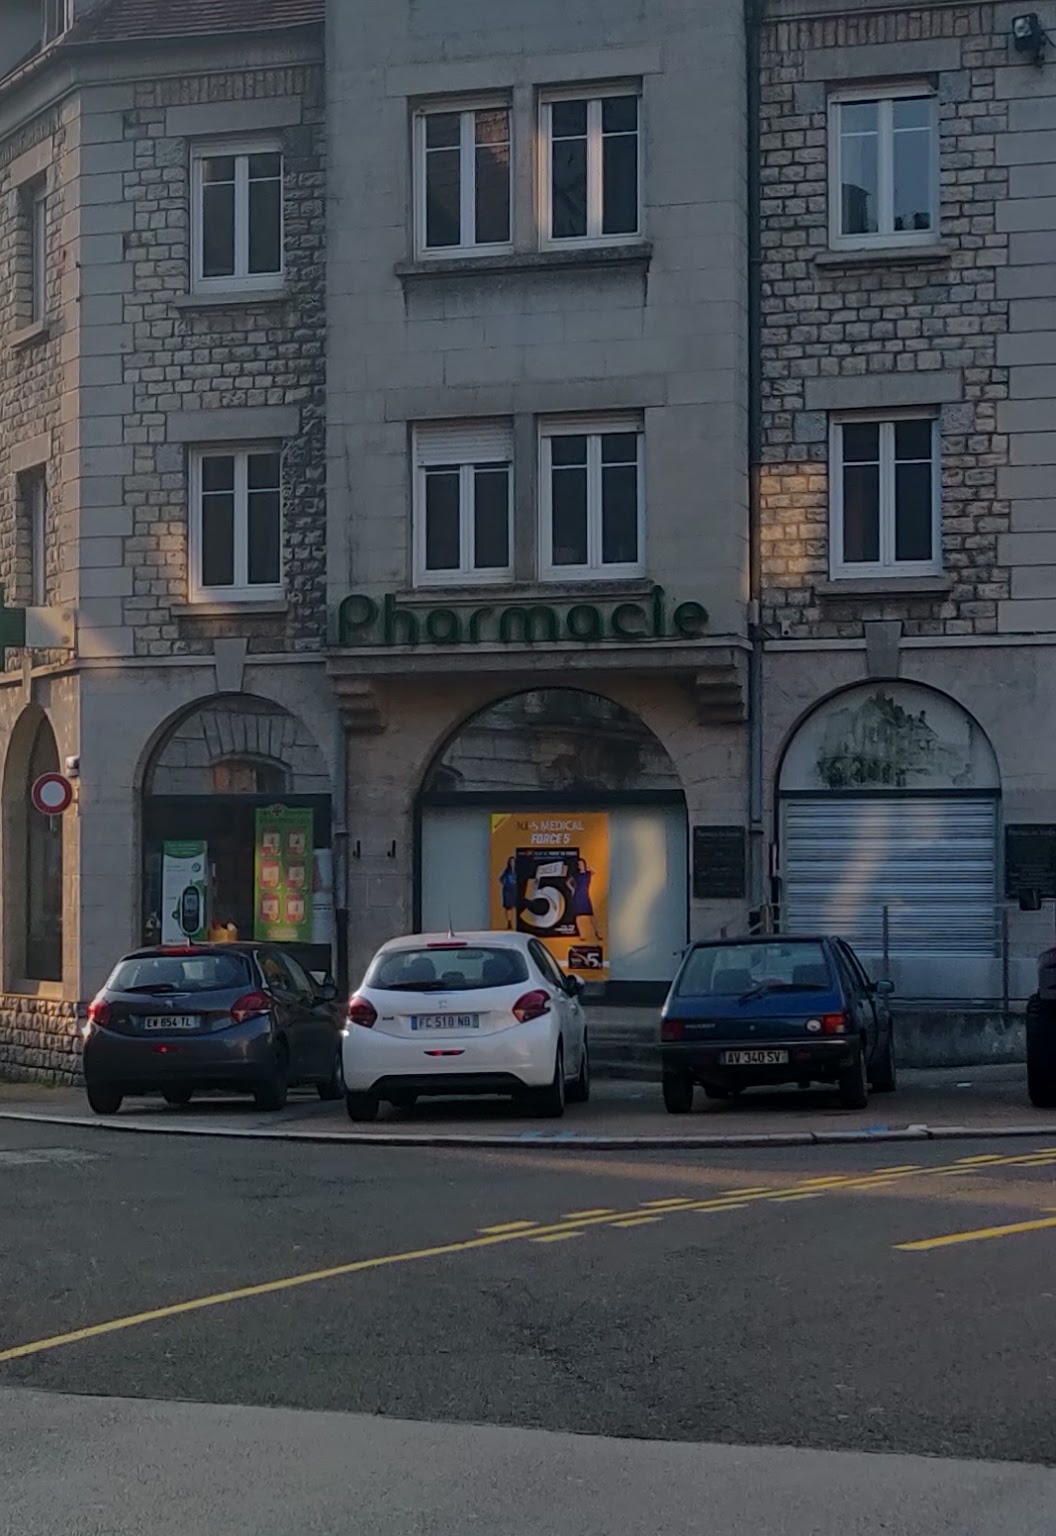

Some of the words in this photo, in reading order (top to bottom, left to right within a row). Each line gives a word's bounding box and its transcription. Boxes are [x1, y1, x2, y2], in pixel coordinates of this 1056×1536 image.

[338, 584, 709, 644] Pharmacie
[541, 820, 585, 831] MEDICAL
[531, 833, 561, 844] FORCE
[563, 833, 571, 844] 5
[519, 861, 568, 928] 5
[161, 1017, 177, 1027] 654
[180, 1017, 192, 1027] TL
[419, 1016, 432, 1028] FC
[728, 1052, 741, 1063] AV
[744, 1051, 765, 1063] 340
[767, 1051, 781, 1063] SV
